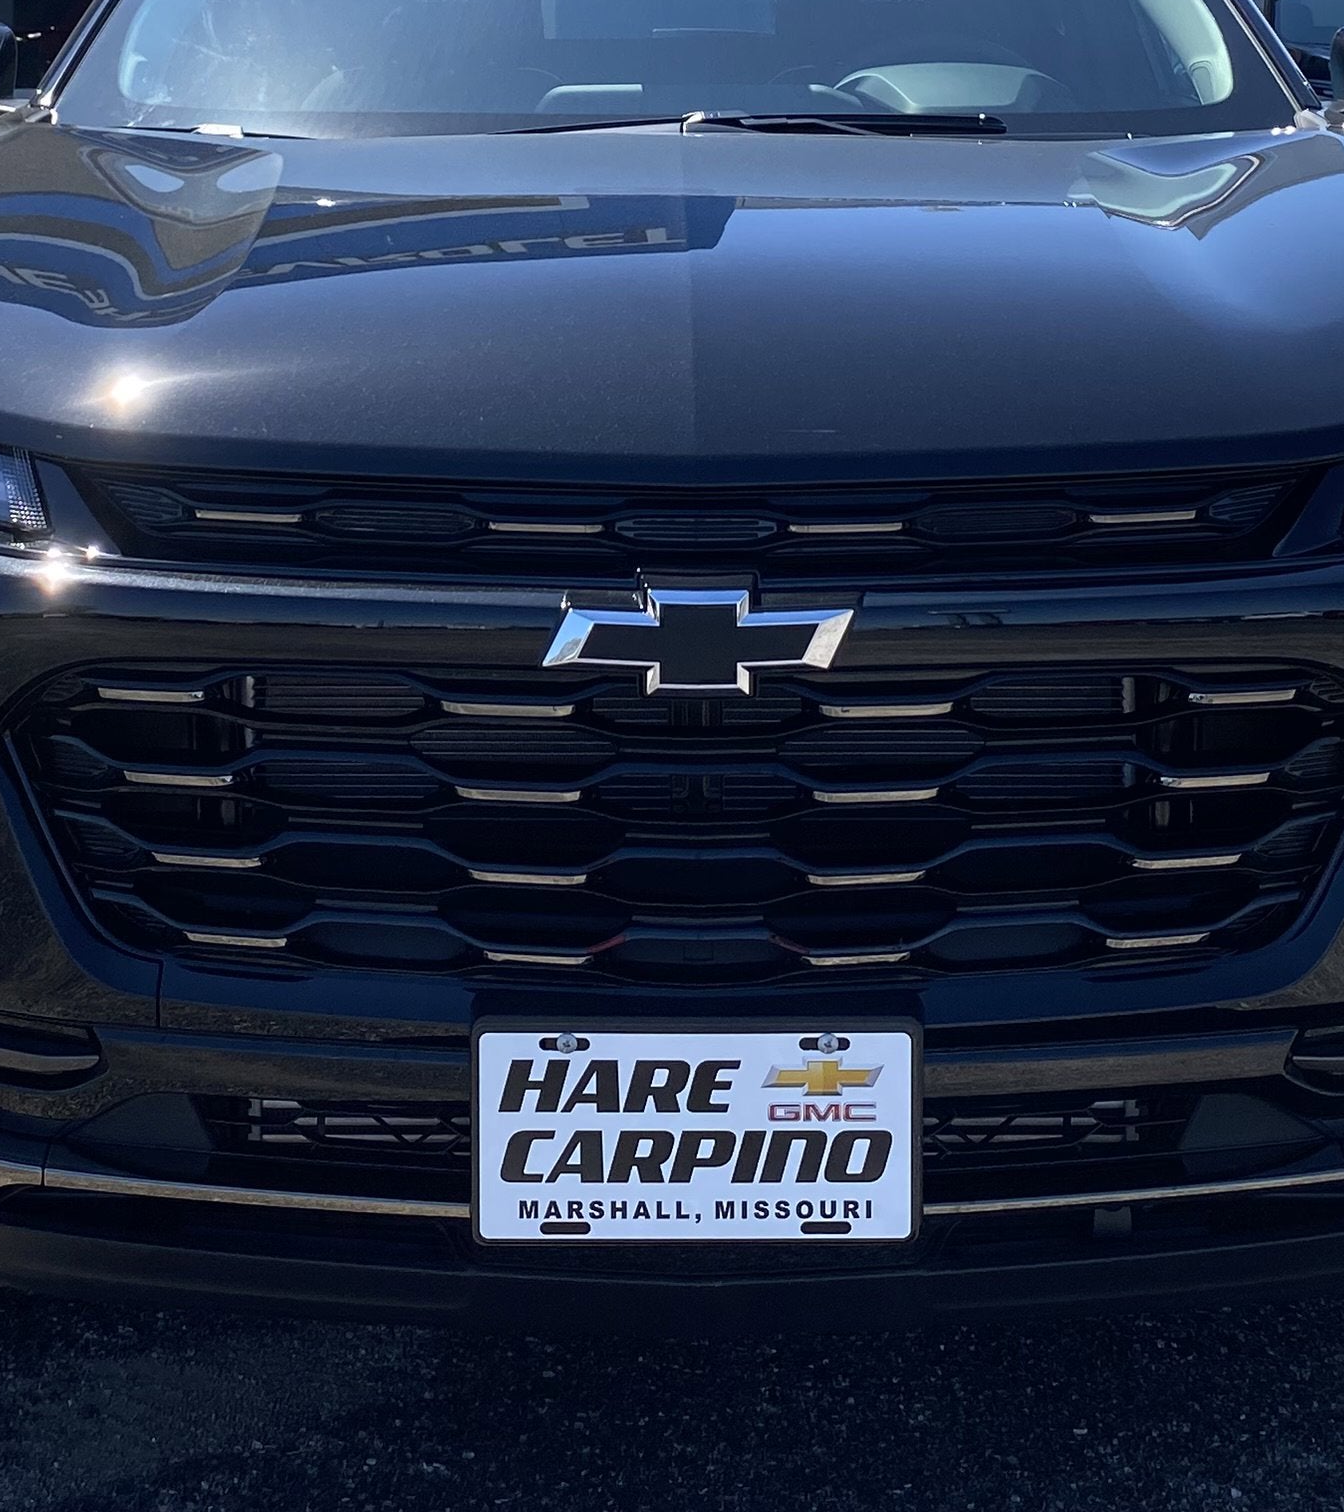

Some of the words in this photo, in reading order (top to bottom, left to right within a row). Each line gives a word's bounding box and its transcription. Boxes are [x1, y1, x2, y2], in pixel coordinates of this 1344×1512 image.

[497, 1058, 742, 1114] HARE
[767, 1101, 878, 1123] GMC
[499, 1129, 893, 1184] CARPINO
[518, 1199, 703, 1224] MARSHALL,
[714, 1199, 873, 1220] MISSOURI
